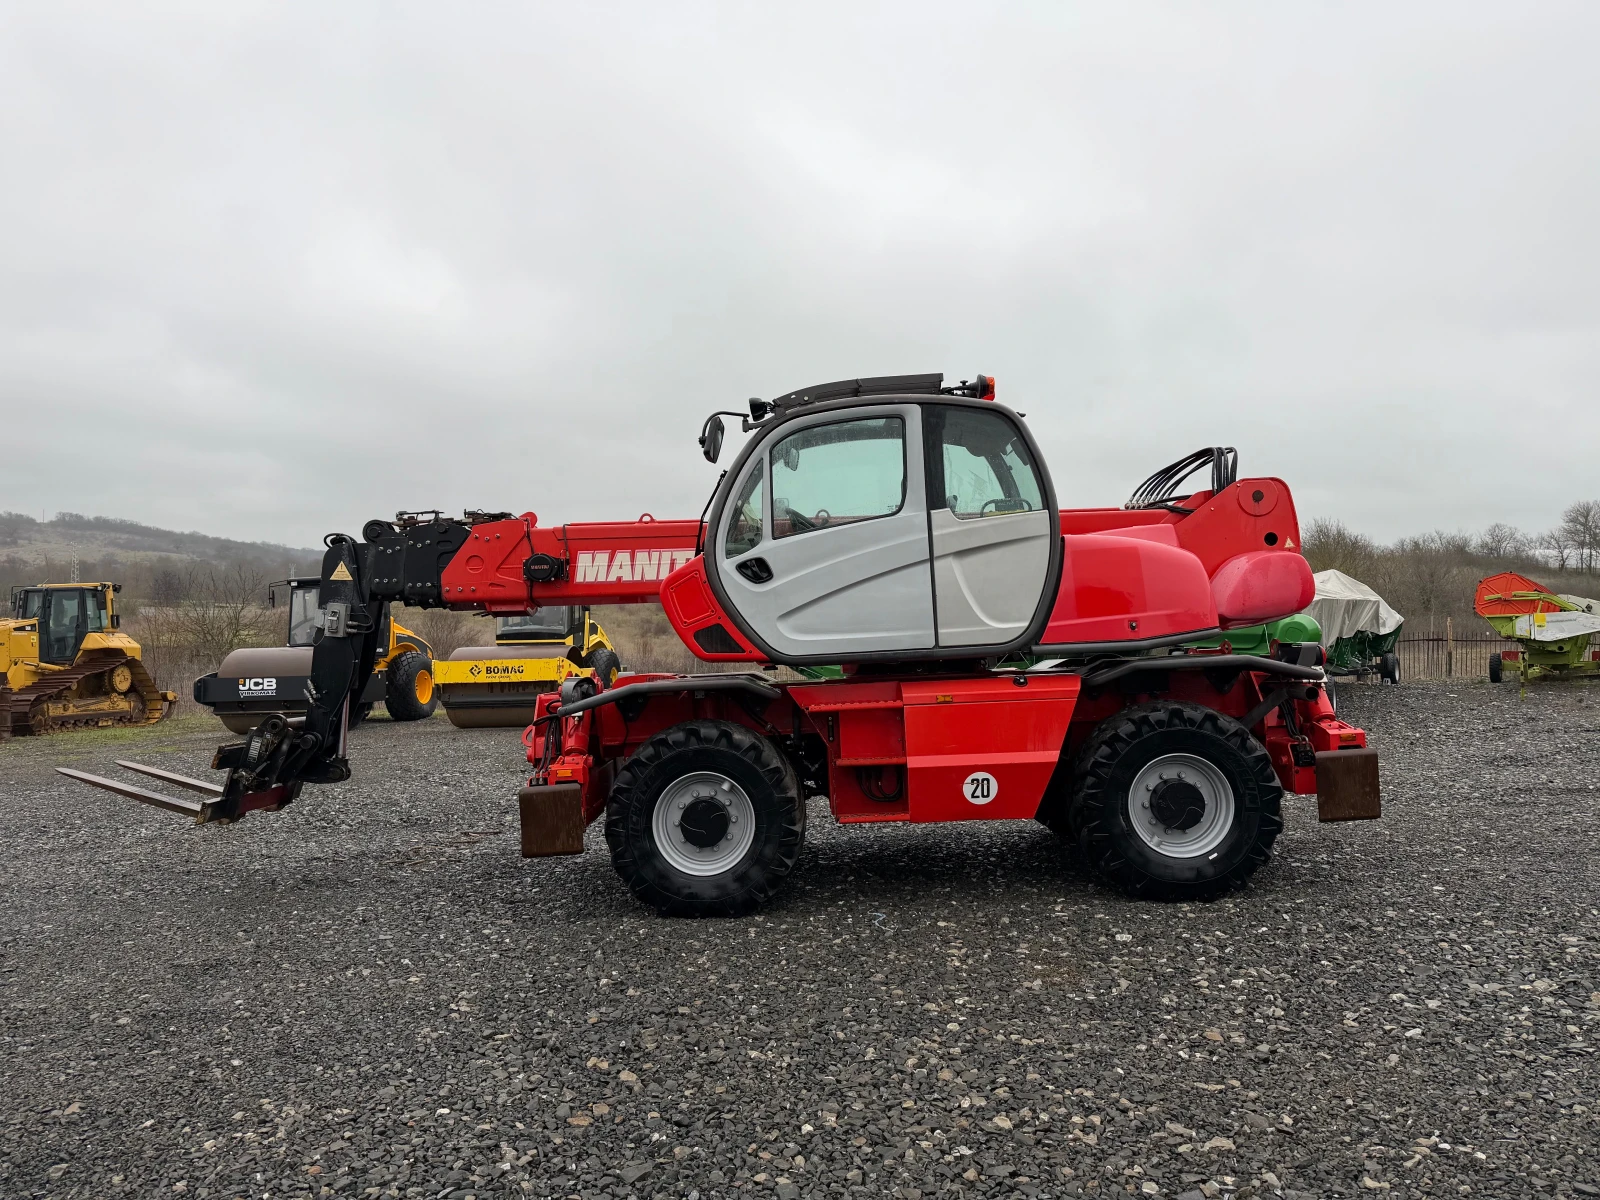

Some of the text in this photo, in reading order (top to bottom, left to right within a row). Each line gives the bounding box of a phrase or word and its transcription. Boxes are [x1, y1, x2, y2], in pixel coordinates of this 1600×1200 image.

[485, 665, 524, 675] BOMAG
[239, 678, 277, 690] JCB
[971, 778, 990, 798] 20
